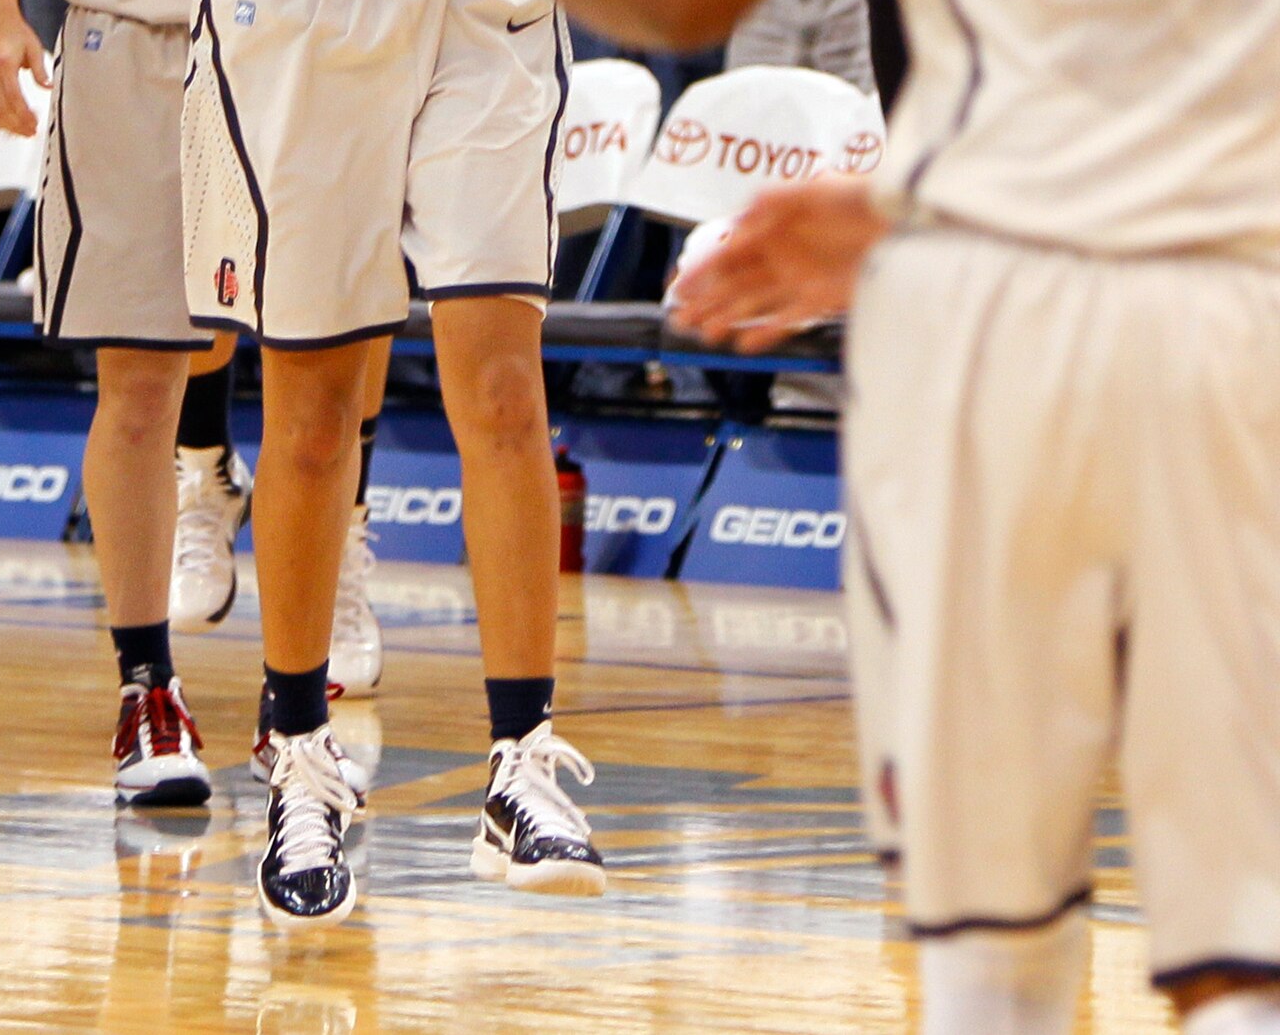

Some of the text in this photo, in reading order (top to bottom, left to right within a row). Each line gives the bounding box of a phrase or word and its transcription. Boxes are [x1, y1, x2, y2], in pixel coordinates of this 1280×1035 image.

[718, 134, 823, 180] TOYOT
[368, 487, 462, 526] EICO
[584, 496, 676, 535] EICO
[710, 505, 848, 549] GEICO
